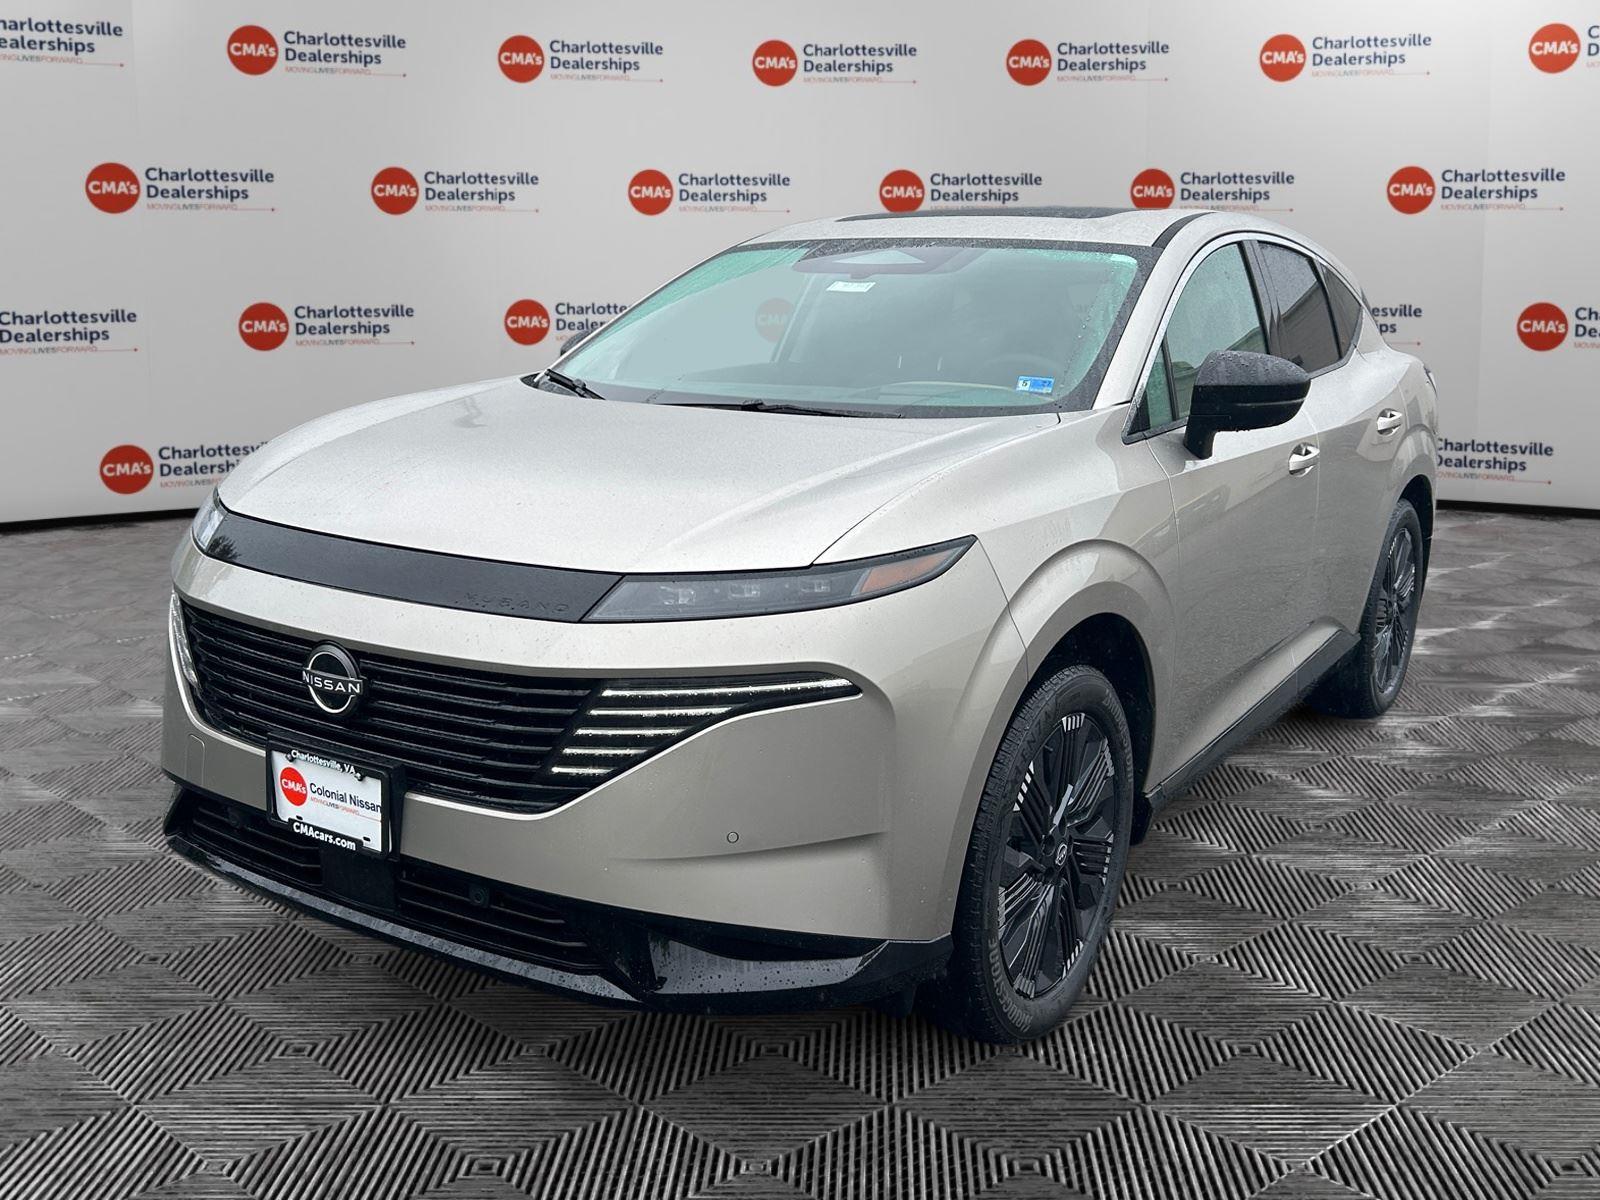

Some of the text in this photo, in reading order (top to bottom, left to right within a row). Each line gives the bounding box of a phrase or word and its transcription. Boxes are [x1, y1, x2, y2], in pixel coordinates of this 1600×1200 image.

[0, 17, 123, 37] arlottesville
[0, 34, 96, 54] ealerships
[283, 30, 406, 49] Charlottesville
[549, 39, 664, 56] Charlottesville
[1312, 33, 1432, 50] Charlottesville
[1531, 39, 1578, 56] CMA's
[231, 43, 276, 58] CMA's
[802, 43, 918, 57] Charlottesville
[1057, 41, 1170, 56] Charlottesville
[284, 47, 382, 68] Dealerships
[501, 52, 542, 66] CMA's
[550, 55, 641, 74] Dealerships
[755, 56, 796, 70] CMA's
[1009, 55, 1050, 69] CMA's
[1057, 57, 1147, 74] Dealerships
[1262, 50, 1305, 65] CMA's
[1312, 51, 1406, 68] Dealerships
[803, 59, 894, 76] Dealerships
[144, 167, 275, 183] Charlottesville
[423, 170, 539, 186] Charlottesville
[678, 172, 791, 187] Charlottesville
[930, 172, 1043, 186] Charlottesville
[1180, 171, 1295, 186] Charlottesville
[1441, 167, 1566, 183] Charlottesville
[88, 180, 138, 195] CMA's
[146, 184, 249, 203] Dealerships
[374, 183, 417, 197] CMA's
[631, 185, 671, 199] CMA's
[882, 185, 923, 199] CMA's
[1133, 184, 1173, 198] CMA's
[1180, 187, 1271, 204] Dealerships
[1390, 182, 1433, 196] CMA's
[1441, 185, 1538, 203] Dealerships
[424, 187, 516, 205] Dealerships
[679, 188, 768, 205] Dealerships
[930, 188, 1019, 205] Dealerships
[0, 308, 137, 326] Charlottesville
[293, 304, 415, 320] Charlottesville
[554, 302, 627, 316] Charlotte
[242, 319, 287, 333] CMA's
[295, 321, 391, 338] Dealerships
[507, 315, 549, 328] CMA's
[556, 318, 606, 331] Dealer
[1520, 319, 1566, 334] CMA's
[0, 327, 110, 345] Dealerships
[158, 443, 266, 461] Charlottesv
[103, 461, 152, 477] CMA's
[160, 459, 240, 477] Dealersh
[302, 669, 361, 694] NISSAN
[309, 782, 382, 814] Colonial Nissan
[292, 821, 357, 851] CMAcars.com
